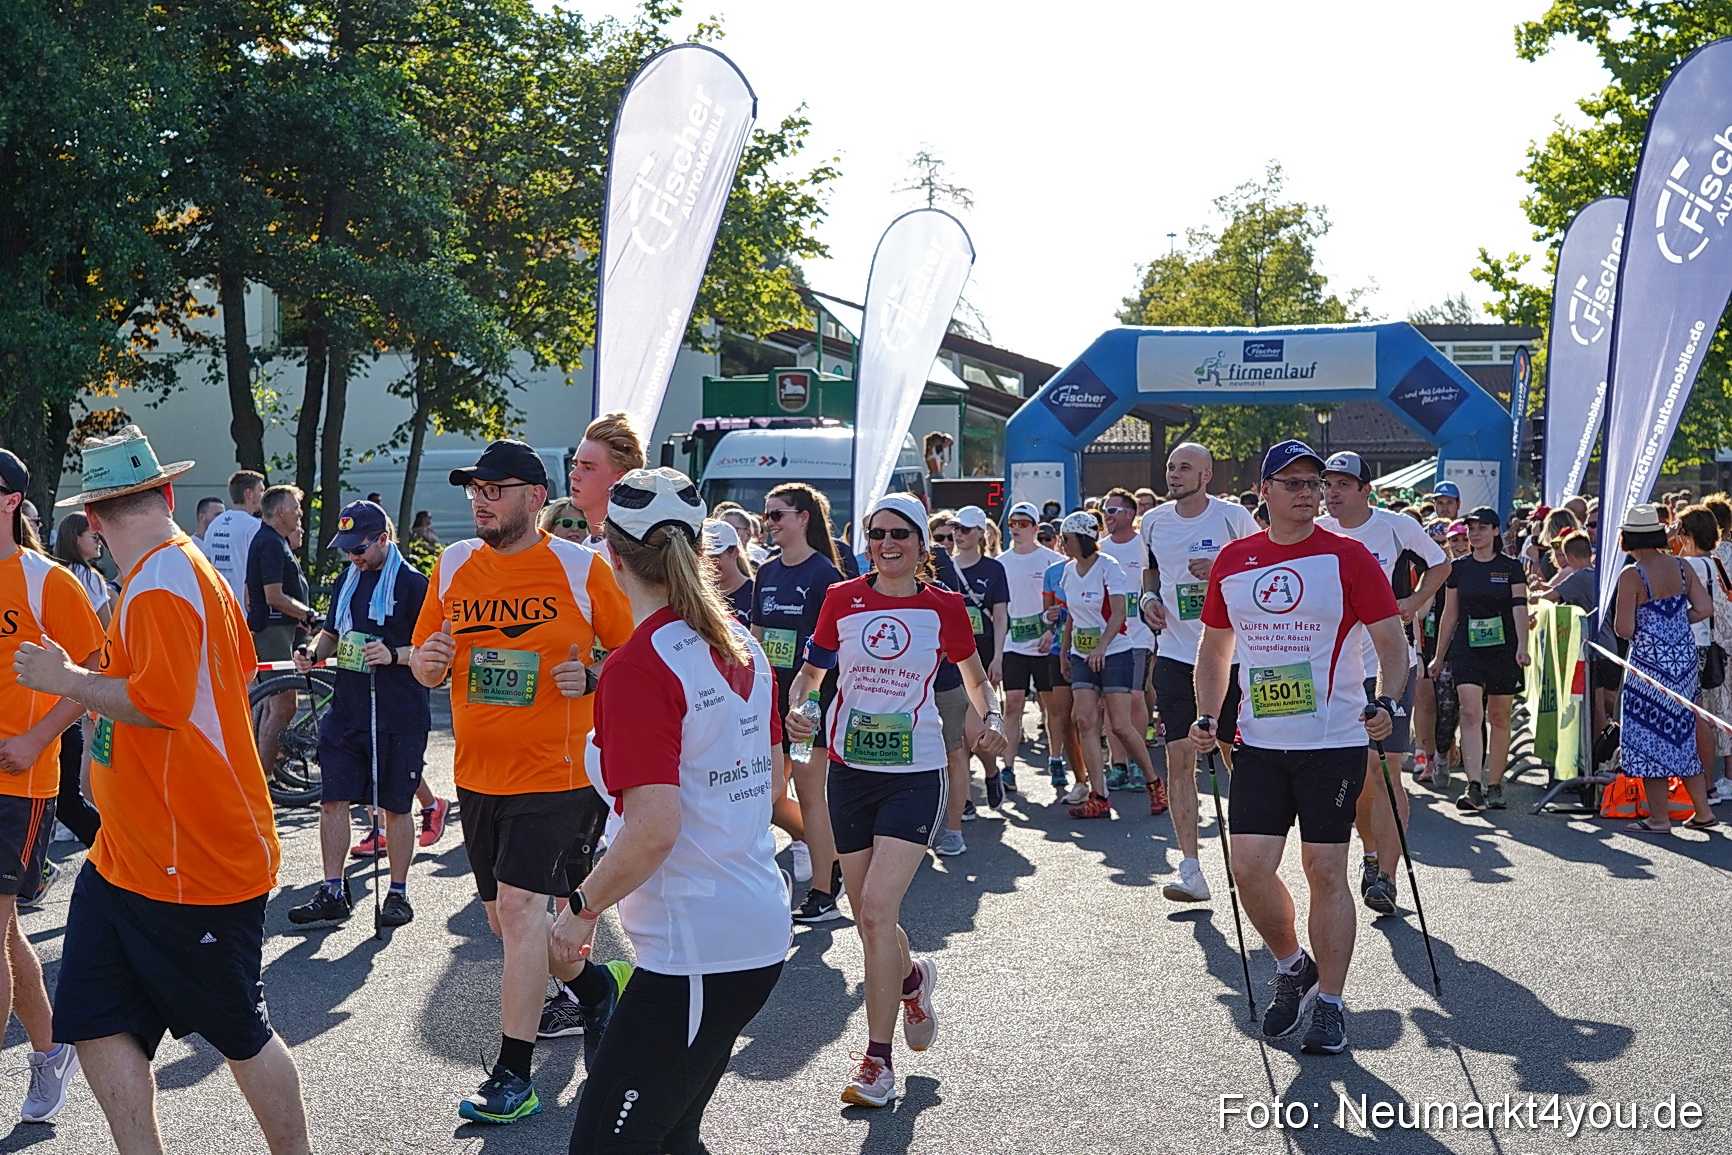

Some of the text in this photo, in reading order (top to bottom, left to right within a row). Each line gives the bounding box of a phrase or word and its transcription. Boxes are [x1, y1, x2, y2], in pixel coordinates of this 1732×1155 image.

[650, 84, 713, 227] Fischer
[681, 103, 726, 220] AUTOMOBILE
[1583, 223, 1624, 326] Fischer
[895, 236, 943, 334] Fischer
[1251, 347, 1281, 355] Fischer
[1229, 361, 1317, 379] firmenlauf
[1059, 392, 1106, 403] Fischer
[452, 596, 558, 622] BIT WINGS
[1272, 622, 1290, 631] MIT
[1294, 620, 1321, 631] HERZ
[766, 640, 789, 655] 1785
[482, 667, 519, 687] 379
[880, 667, 895, 675] MIT
[898, 668, 921, 681] HERZ
[525, 674, 535, 699] 2022
[698, 687, 716, 698] Haus
[891, 680, 910, 689] Röschl
[1259, 681, 1301, 701] 1501
[1304, 682, 1313, 706] 2022
[703, 695, 725, 709] Marien
[853, 730, 901, 749] 1495
[854, 748, 878, 756] Fischer
[708, 762, 749, 788] Praxis
